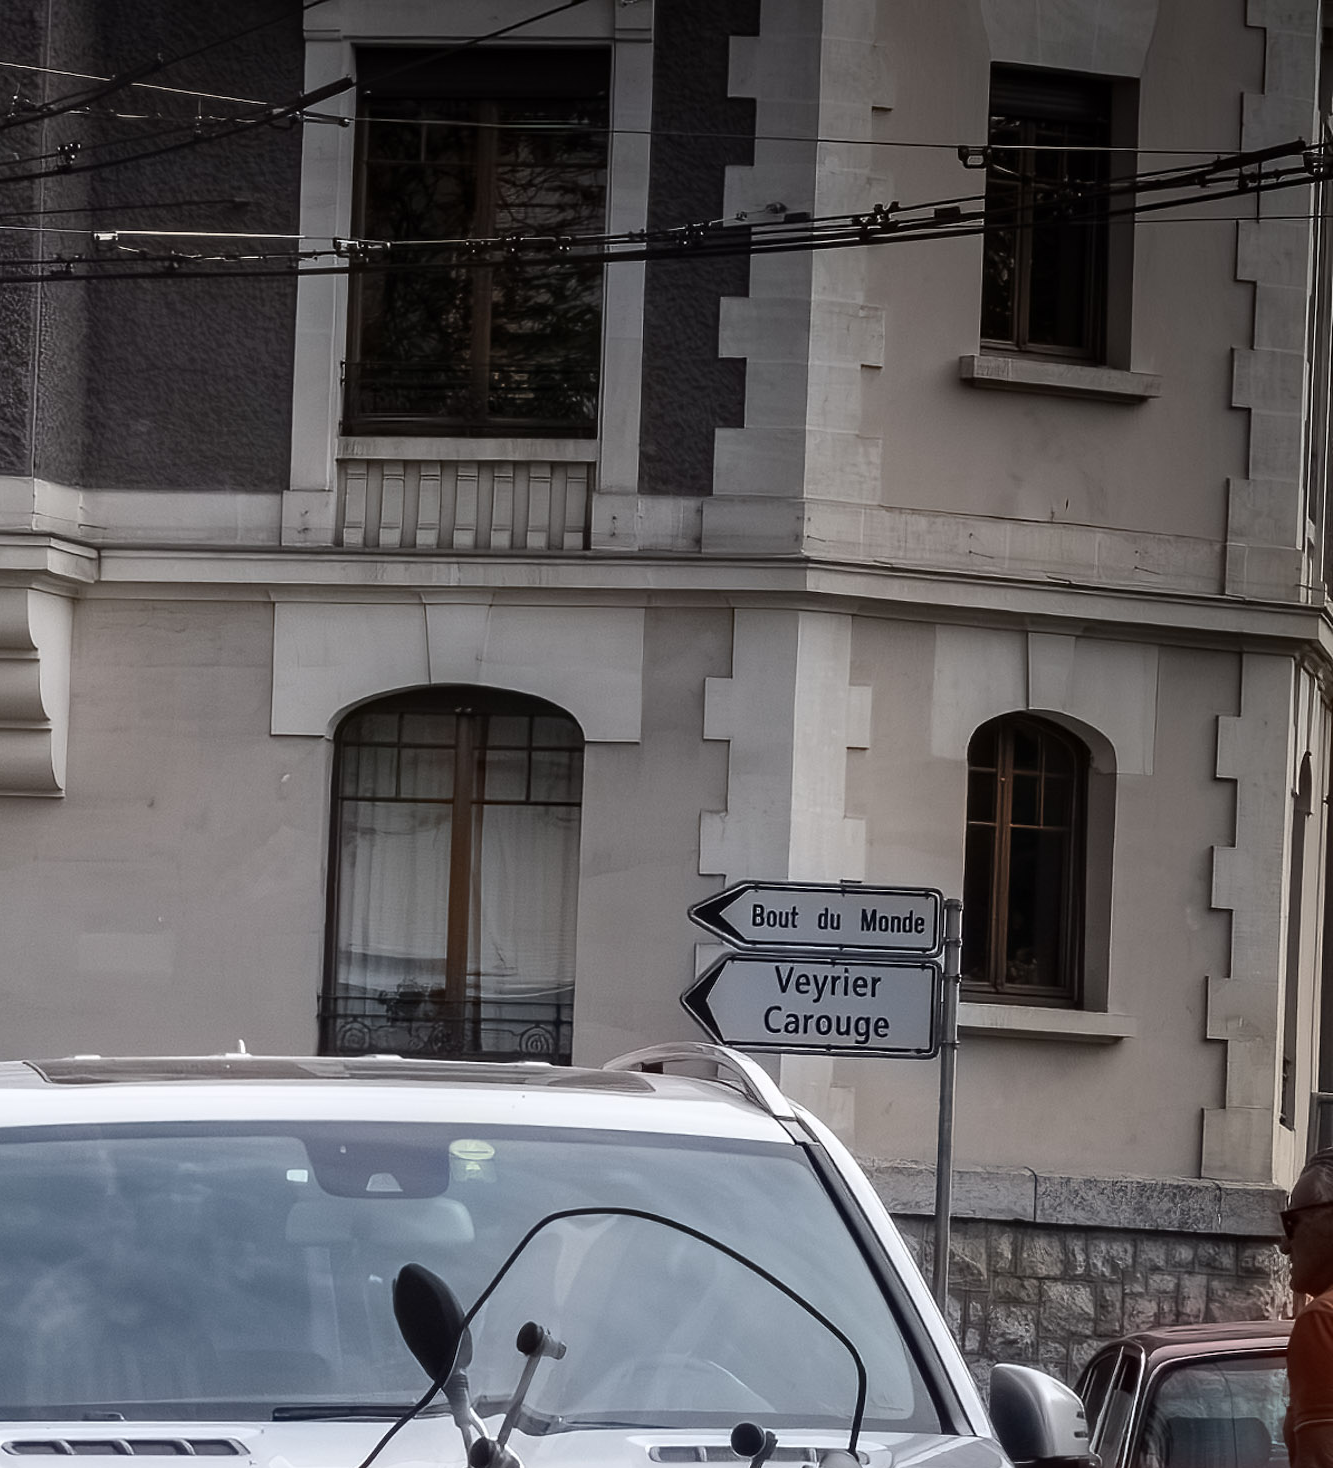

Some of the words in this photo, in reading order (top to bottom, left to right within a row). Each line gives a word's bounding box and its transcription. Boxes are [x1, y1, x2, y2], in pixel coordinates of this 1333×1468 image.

[751, 904, 799, 929] Bout
[817, 907, 841, 931] du
[860, 908, 925, 935] Monde
[774, 965, 883, 1004] Veyrier
[763, 1005, 890, 1045] Carouge
